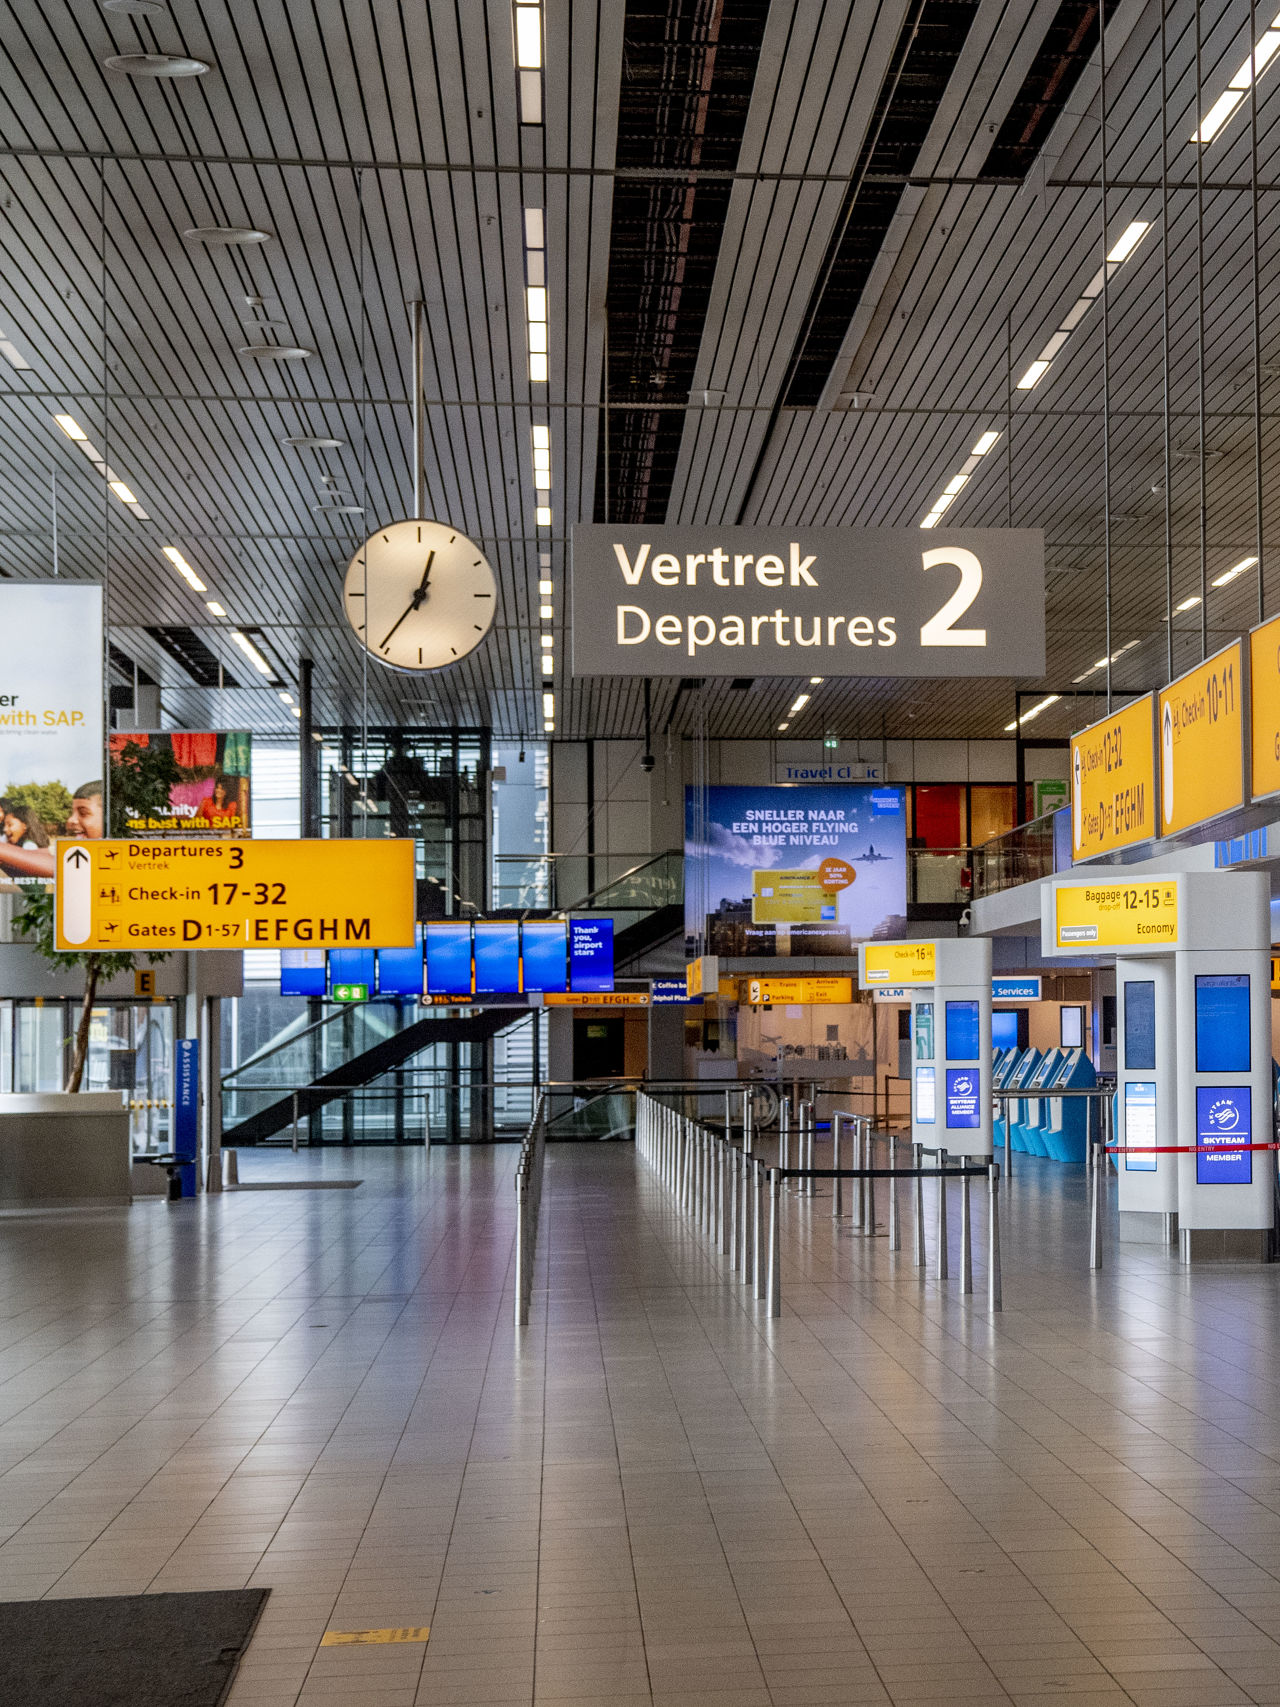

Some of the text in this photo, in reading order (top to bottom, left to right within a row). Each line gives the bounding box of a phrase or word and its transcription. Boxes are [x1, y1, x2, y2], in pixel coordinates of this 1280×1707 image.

[613, 542, 819, 587] Vertrek
[616, 546, 986, 656] Departures 2
[1207, 664, 1234, 725] 10-11
[43, 710, 86, 727] SAP.
[1104, 726, 1123, 773] 12-32
[786, 767, 880, 779] Travel Clic
[745, 810, 845, 821] SNELLER NAAR
[181, 817, 209, 829] with
[212, 816, 243, 829] SAP.
[732, 822, 859, 833] EEN HOGER FLYING
[753, 834, 839, 846] BLUE NIVEAU
[129, 844, 244, 869] Departures 3
[128, 861, 169, 870] Vertrek
[128, 883, 287, 905] Check-in 17-32
[1086, 889, 1160, 909] Baggage 12-15
[128, 924, 176, 937] Gates
[1137, 923, 1175, 935] Economy
[894, 948, 926, 960] Check-in 16
[912, 968, 934, 977] Economy
[140, 973, 150, 991] E
[997, 987, 1034, 996] Services
